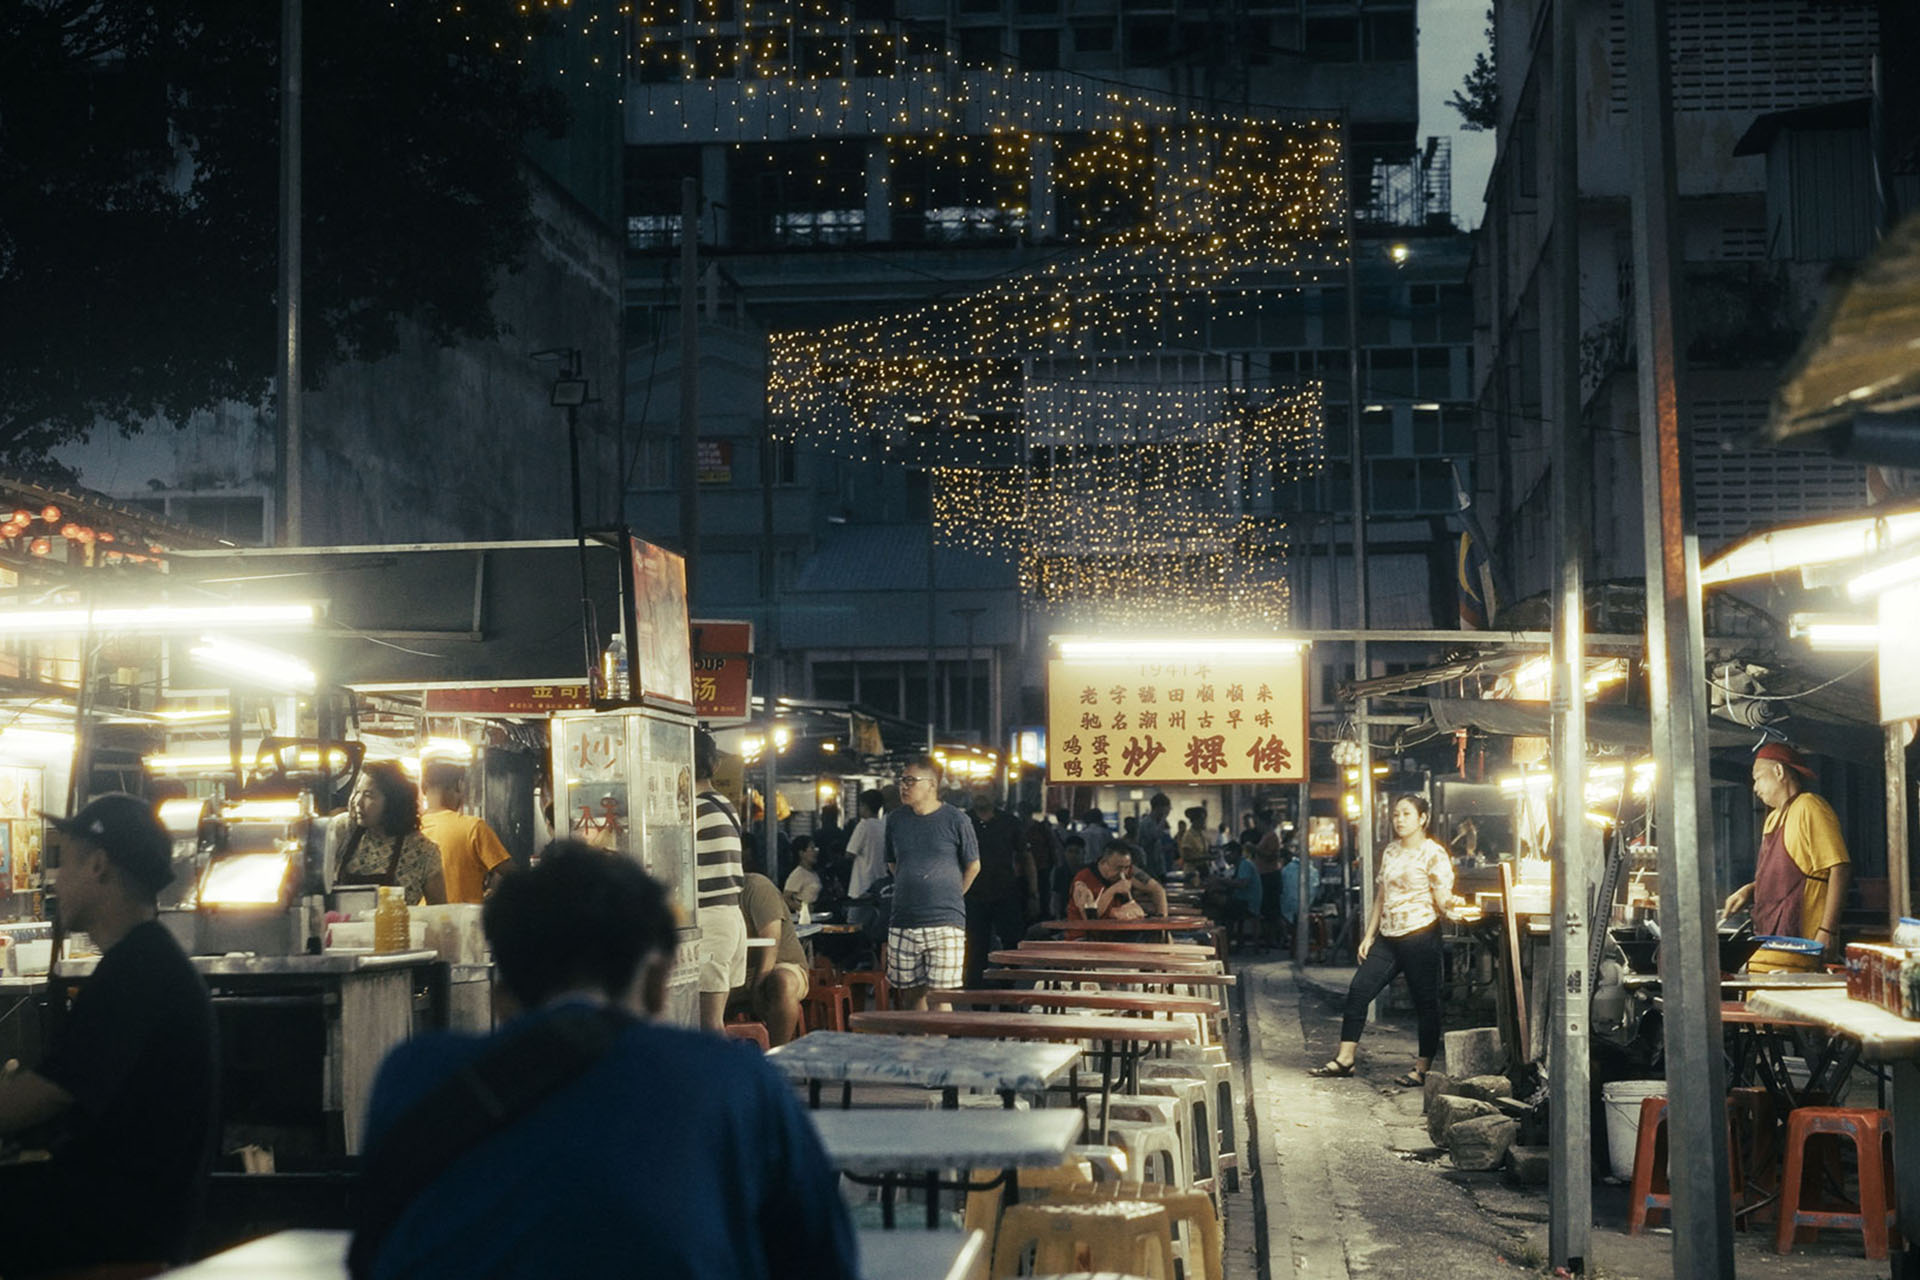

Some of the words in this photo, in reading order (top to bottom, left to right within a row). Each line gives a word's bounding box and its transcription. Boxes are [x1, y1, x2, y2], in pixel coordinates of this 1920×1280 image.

[694, 658, 726, 671] OUP
[1080, 710, 1274, 730] 驰名潮州古早味
[1062, 734, 1111, 755] 鸡蛋
[1121, 734, 1292, 777] 炒粿條
[1063, 757, 1112, 777] 鸭蛋
